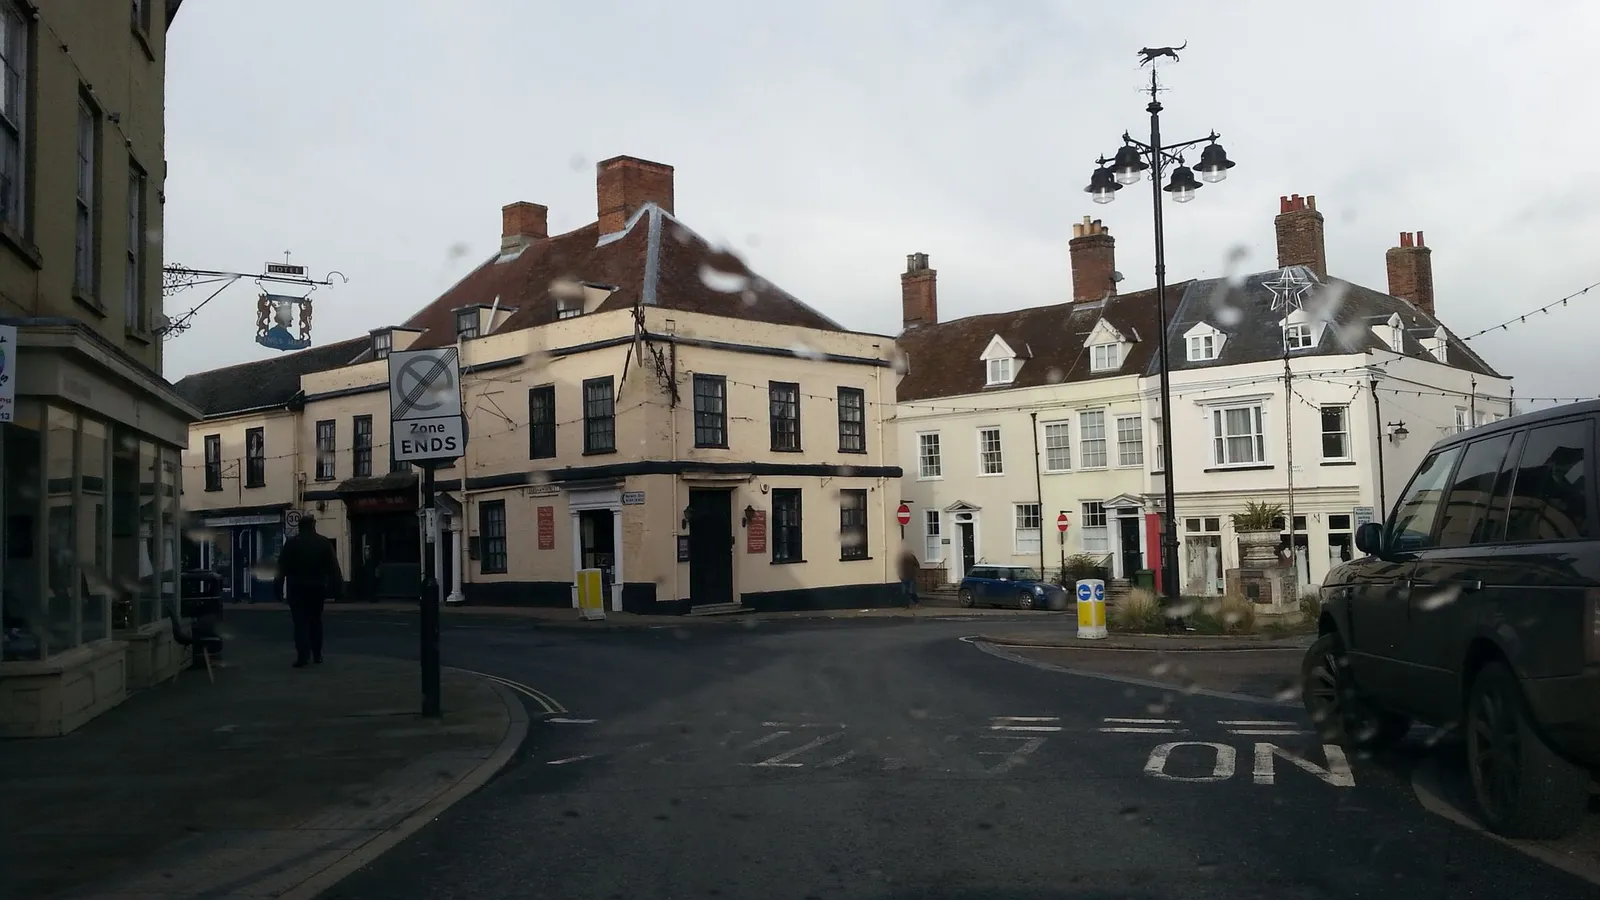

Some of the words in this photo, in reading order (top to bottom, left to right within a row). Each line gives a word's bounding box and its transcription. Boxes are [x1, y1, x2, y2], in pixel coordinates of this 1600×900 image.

[270, 265, 300, 274] HOTEL
[410, 422, 445, 434] Zone
[401, 436, 457, 454] ENDS
[289, 515, 300, 523] 30
[1143, 742, 1356, 787] NO
